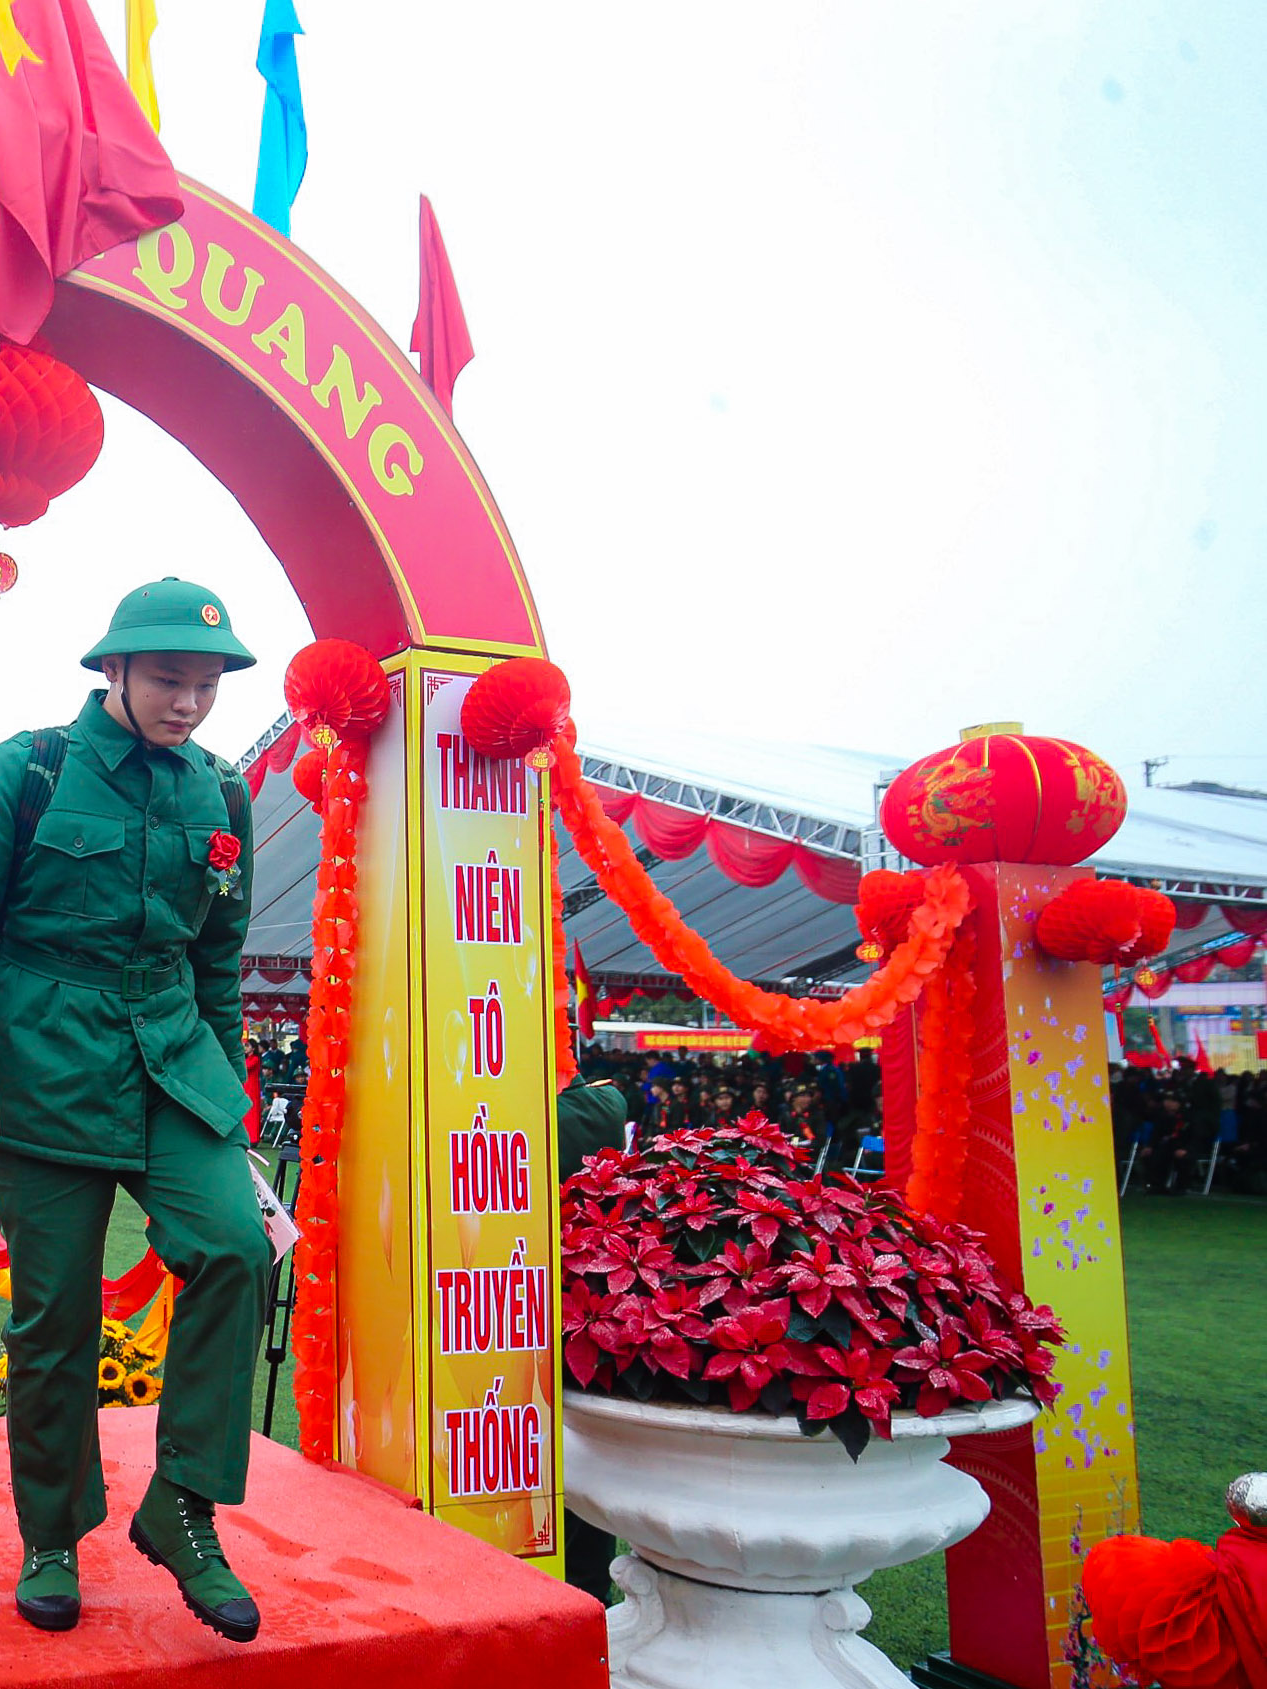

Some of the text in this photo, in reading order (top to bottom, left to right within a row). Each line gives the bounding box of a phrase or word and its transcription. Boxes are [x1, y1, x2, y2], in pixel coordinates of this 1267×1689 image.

[132, 222, 424, 497] QUANG
[315, 728, 332, 745] 福
[454, 847, 523, 946] NIÊN
[467, 979, 506, 1079] TÔ
[449, 1102, 531, 1215] HỒNG
[436, 1237, 548, 1355] TRUYỀN
[445, 1376, 542, 1498] THỐNG
